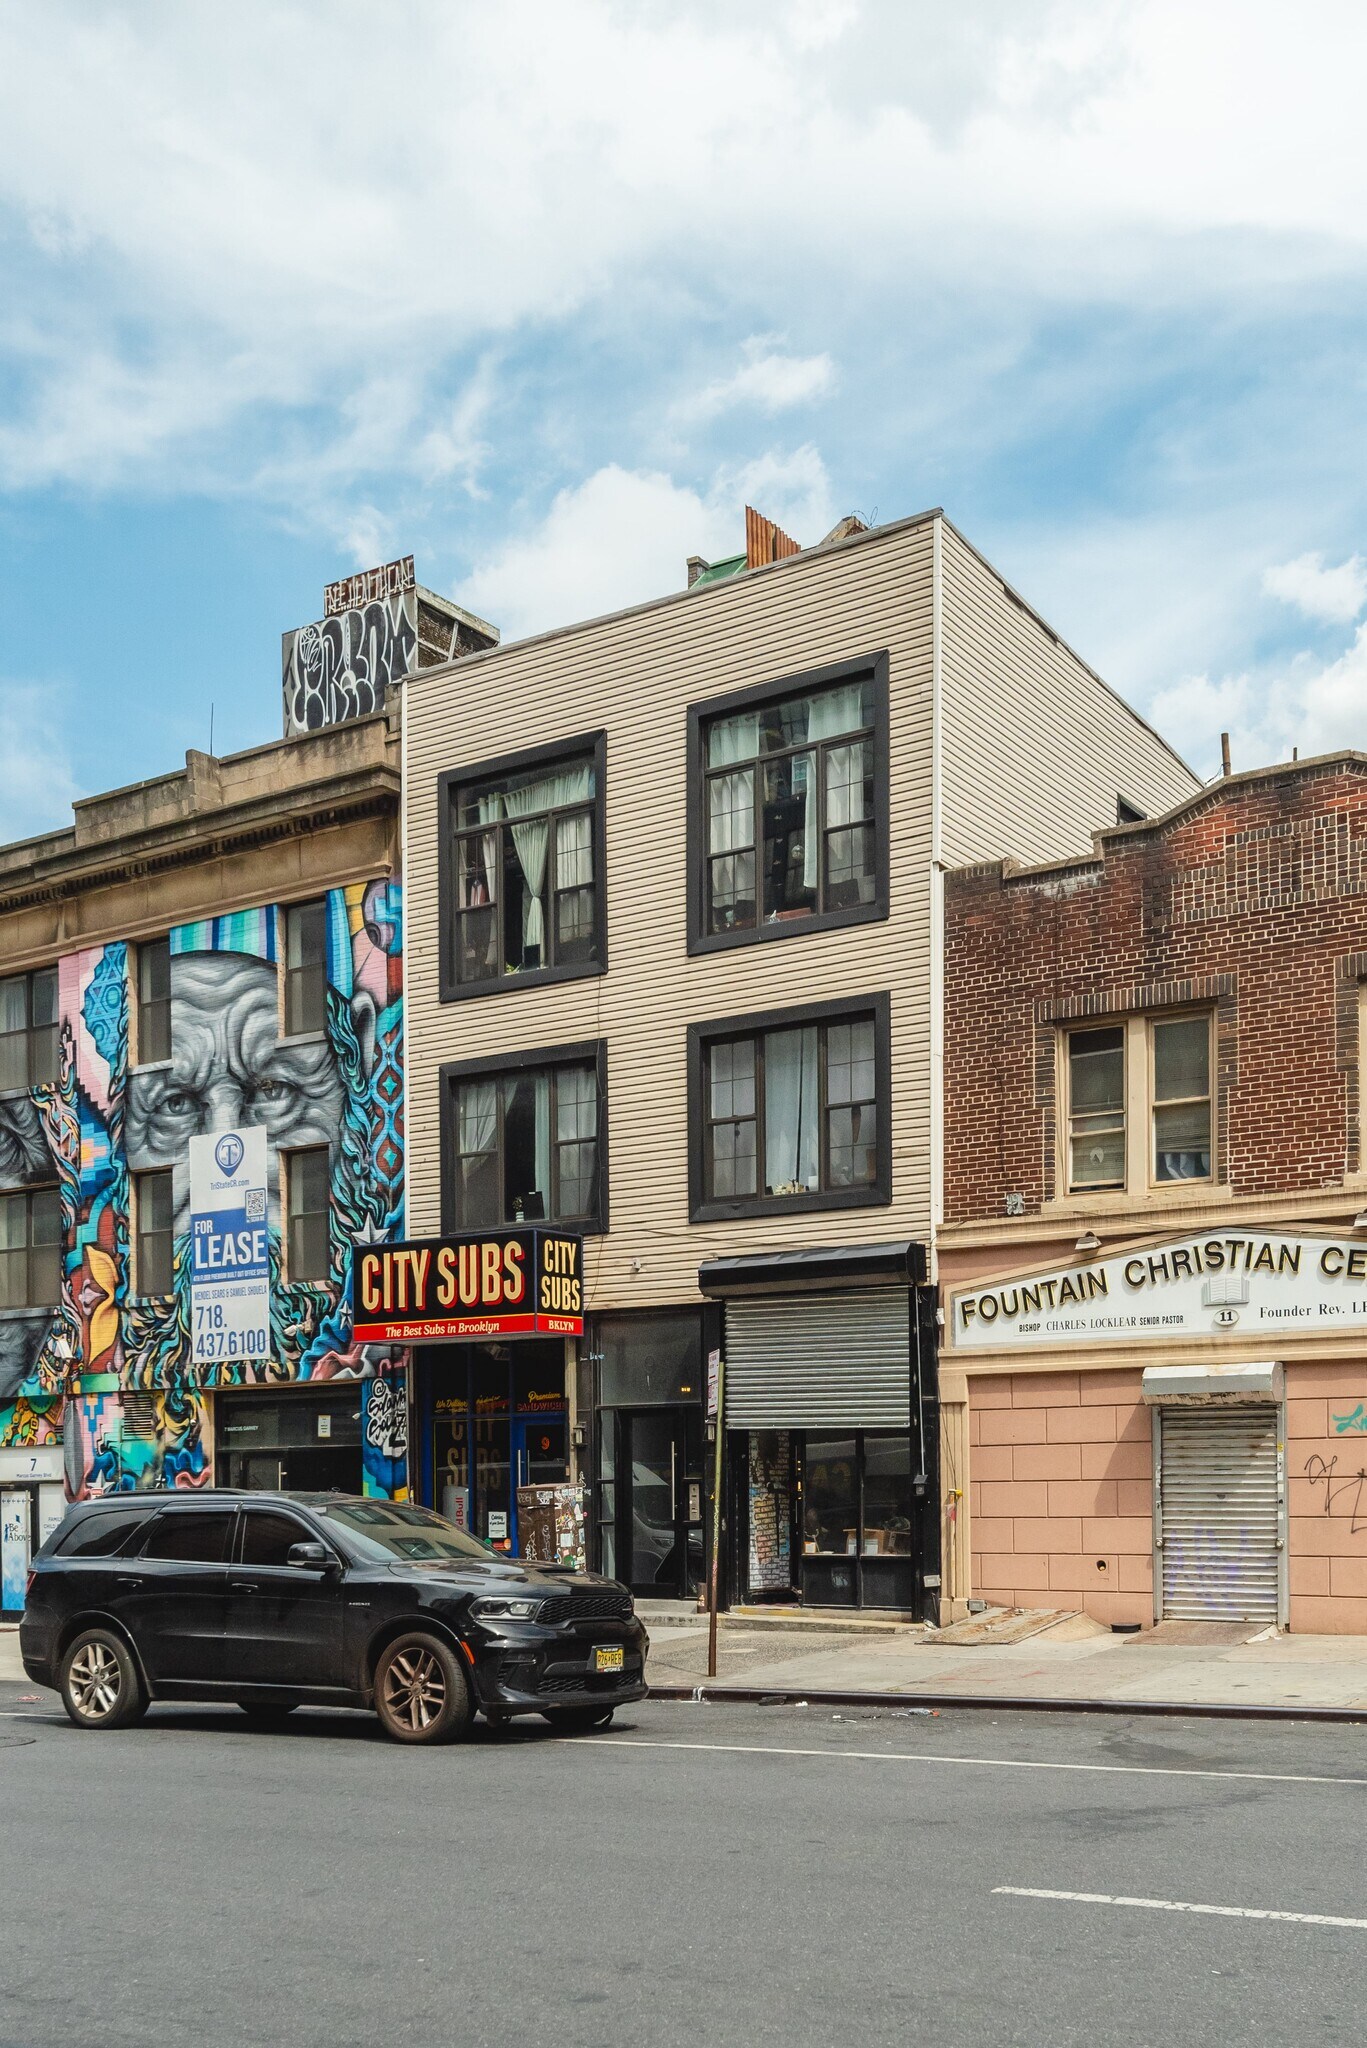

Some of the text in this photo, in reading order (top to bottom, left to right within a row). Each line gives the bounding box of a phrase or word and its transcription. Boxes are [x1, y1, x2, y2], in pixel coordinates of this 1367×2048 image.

[194, 1219, 213, 1235] FOR
[195, 1230, 267, 1269] LEASE
[543, 1239, 577, 1275] CITY
[361, 1240, 525, 1312] CITY SUBS
[960, 1268, 1109, 1327] FOUNTAIN
[1123, 1239, 1302, 1288] CHRISTIAN
[541, 1275, 581, 1311] SUBS
[195, 1304, 228, 1330] 718.
[1219, 1311, 1233, 1322] 11
[1259, 1305, 1312, 1318] Founder
[1318, 1303, 1345, 1315] Rev.
[385, 1320, 500, 1338] The Best Subs in Brooklyn
[548, 1319, 575, 1331] BKLYN
[1018, 1314, 1184, 1333] BISHOP CHARLES LOCKLEAR SENIOR PASTOR
[196, 1328, 266, 1358] 437.6100
[30, 1458, 37, 1472] 7
[455, 1497, 464, 1517] Bull
[9, 1523, 19, 1532] Be
